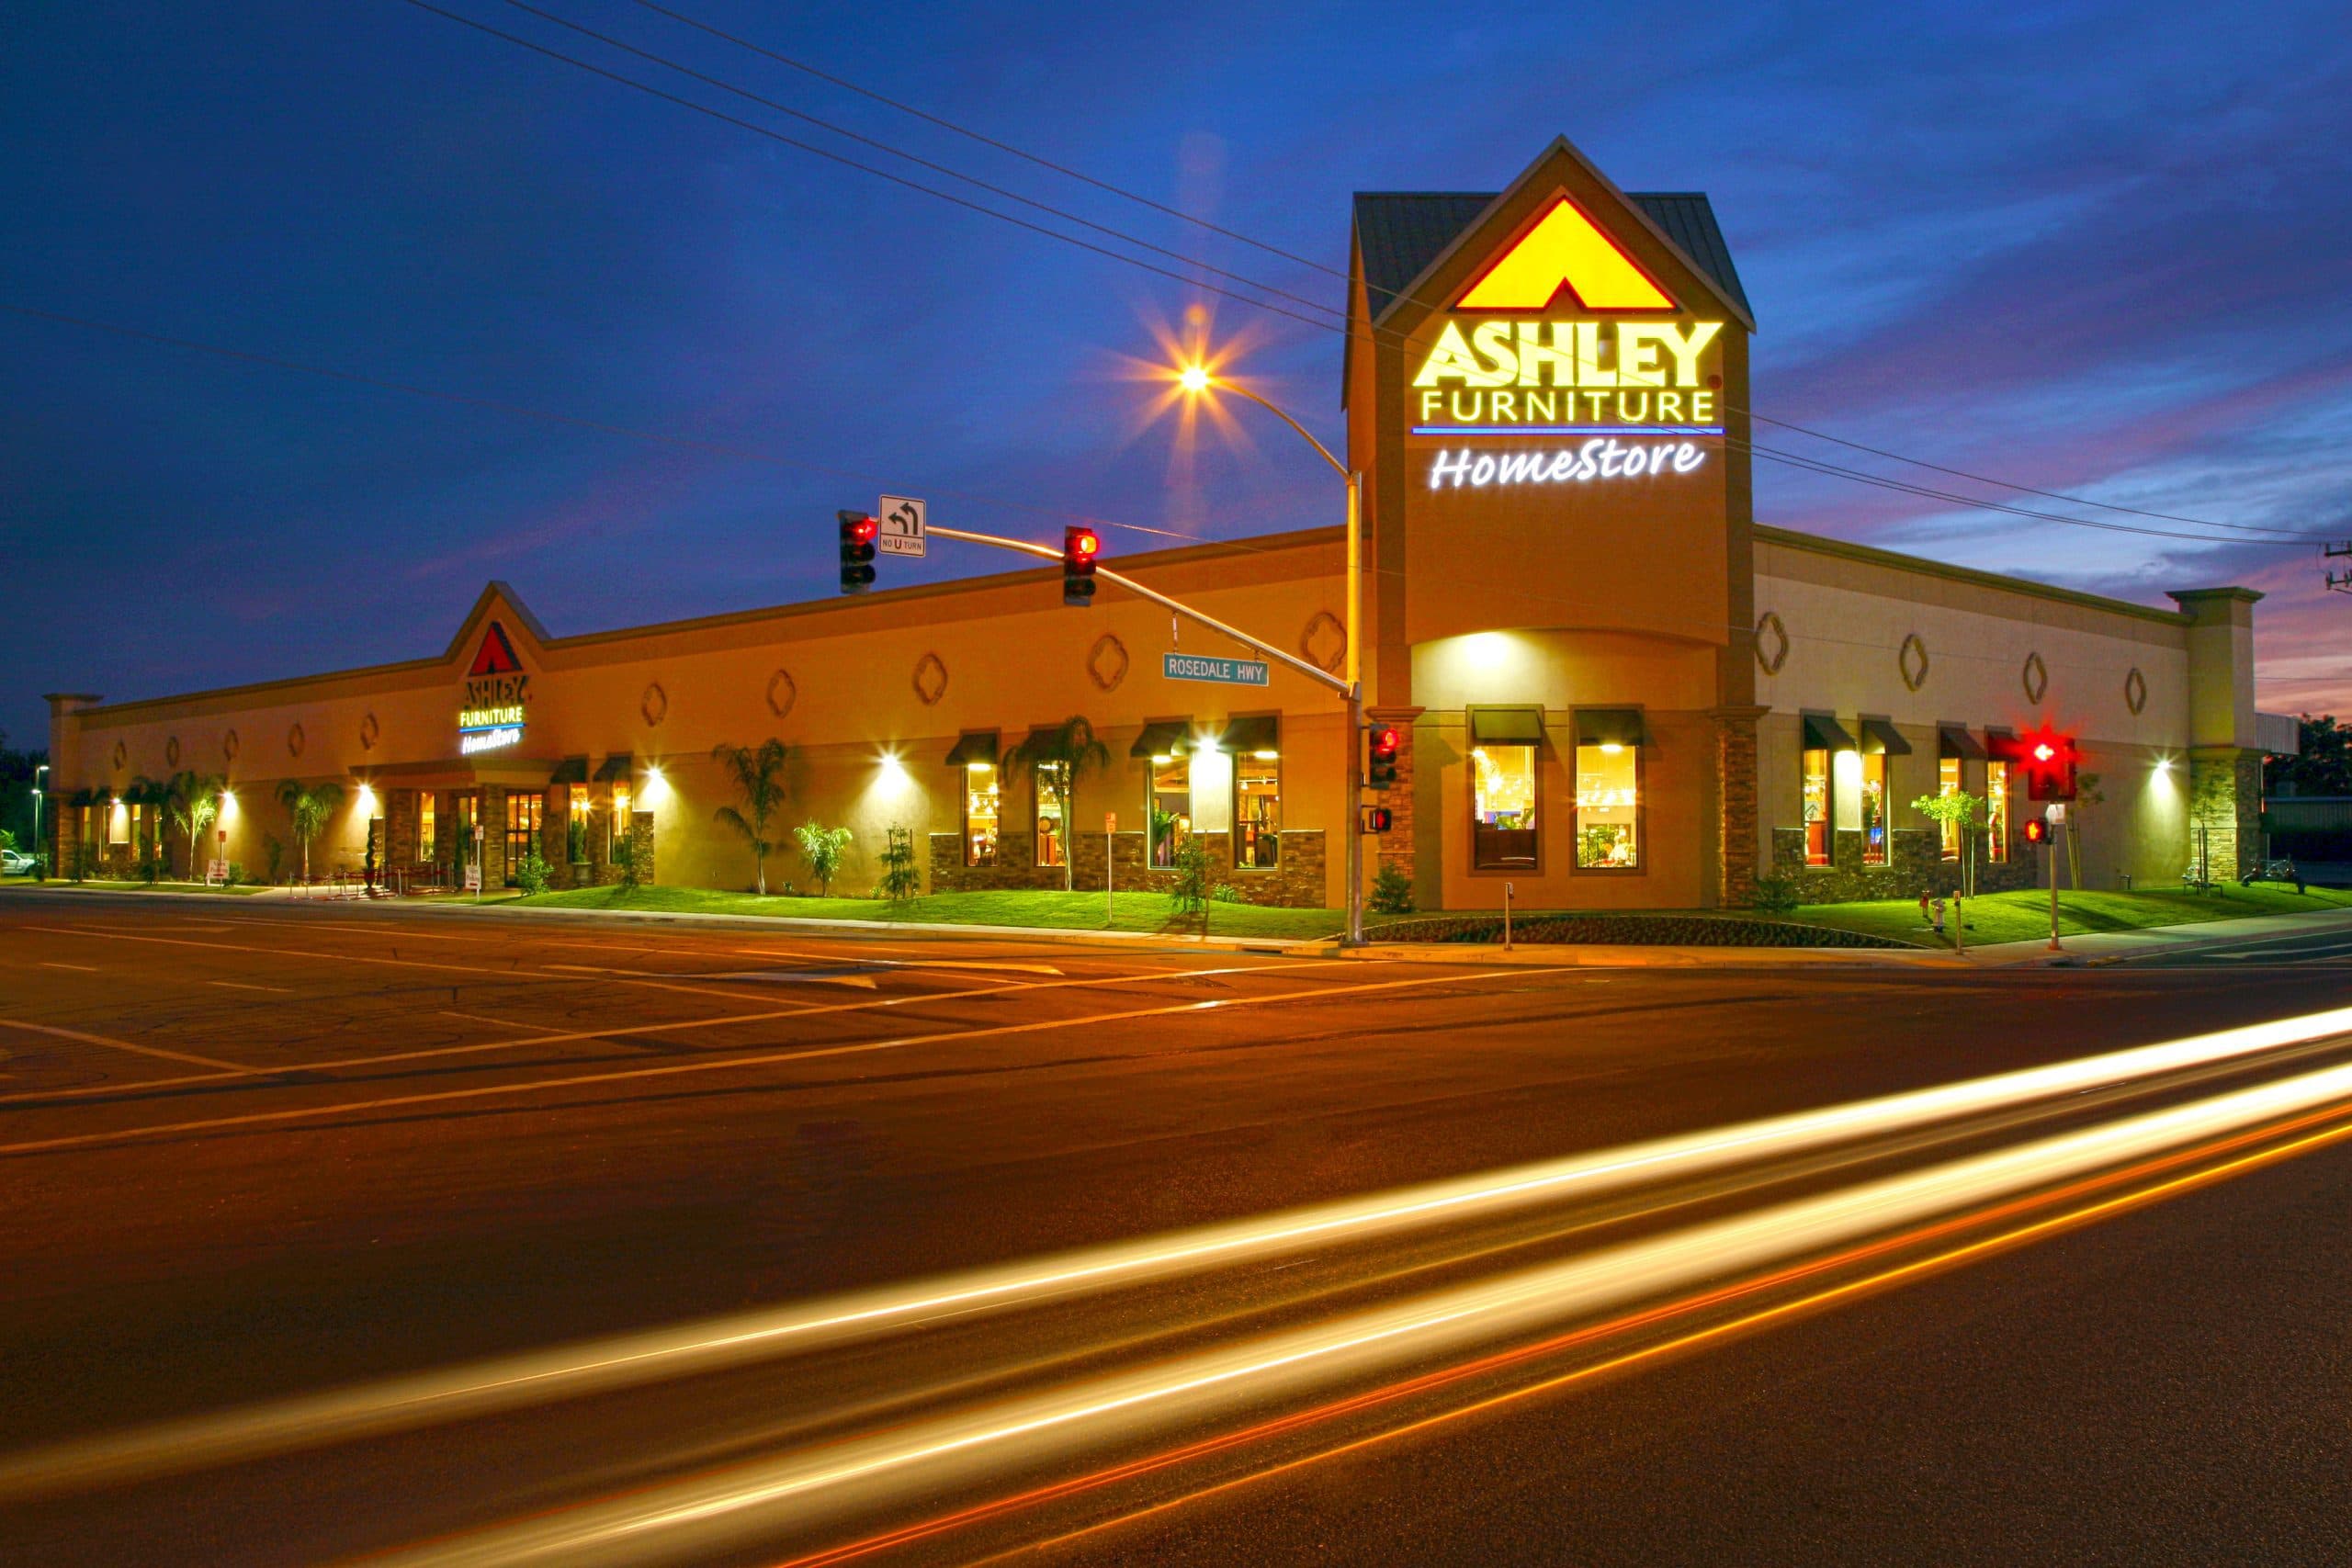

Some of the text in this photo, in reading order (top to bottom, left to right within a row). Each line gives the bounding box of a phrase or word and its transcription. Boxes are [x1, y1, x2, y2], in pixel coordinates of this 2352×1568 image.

[1412, 321, 1724, 388] ASHLEY
[1421, 391, 1714, 422] FURNITURE
[1429, 439, 1705, 490] HomeStore
[894, 538, 902, 549] U
[904, 541, 922, 550] TURN
[1169, 659, 1263, 682] ROSEDALE HWY
[463, 675, 528, 710] ASHLEY
[460, 706, 523, 727] FURNITURE
